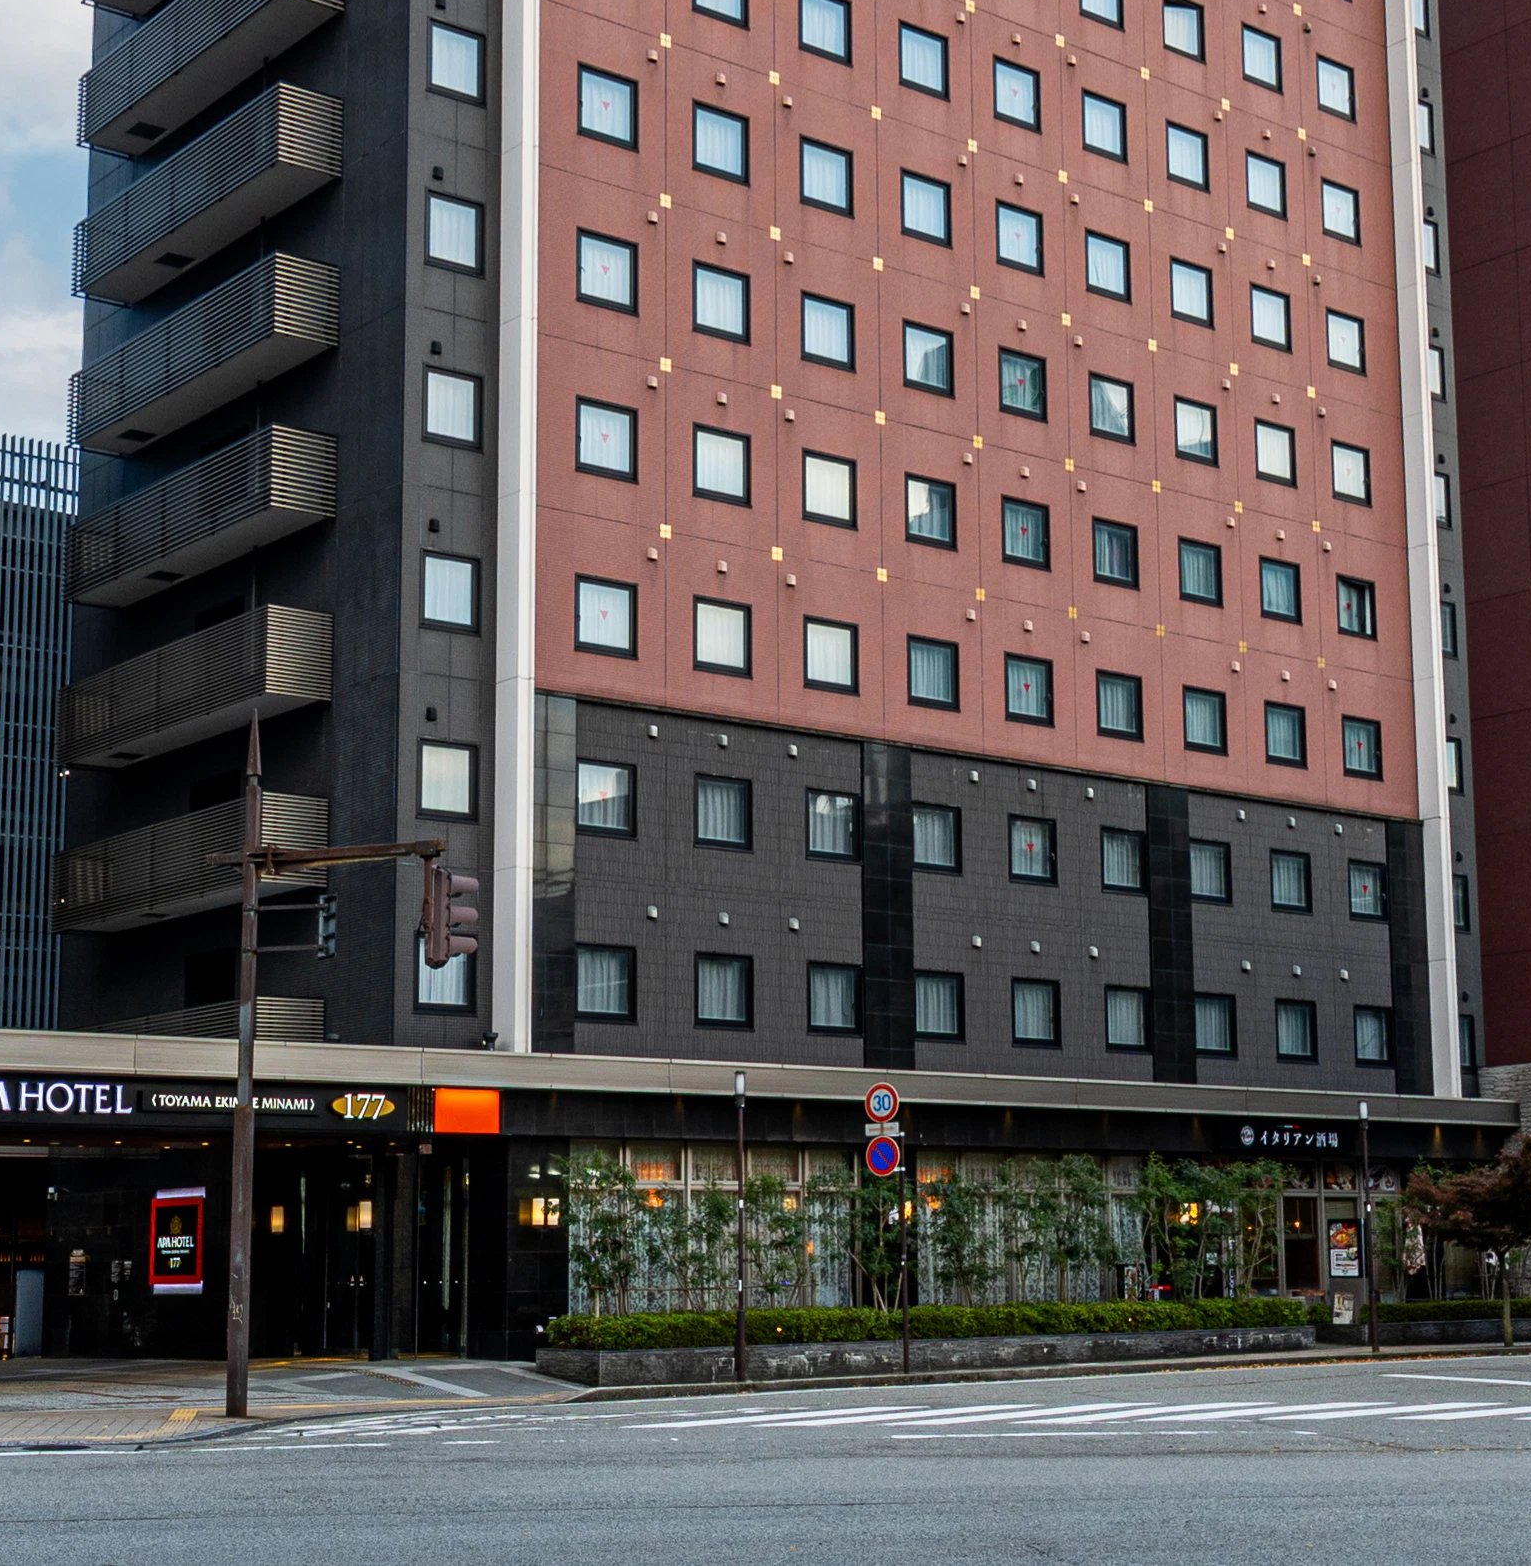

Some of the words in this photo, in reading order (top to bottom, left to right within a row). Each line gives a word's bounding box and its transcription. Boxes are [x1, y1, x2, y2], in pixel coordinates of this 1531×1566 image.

[19, 1081, 132, 1114] HOTEL
[215, 1096, 259, 1110] EKIE
[343, 1093, 386, 1120] 177
[873, 1094, 891, 1112] 30
[1260, 1130, 1338, 1148] イタリアン酒場
[171, 1235, 195, 1248] HOTEL
